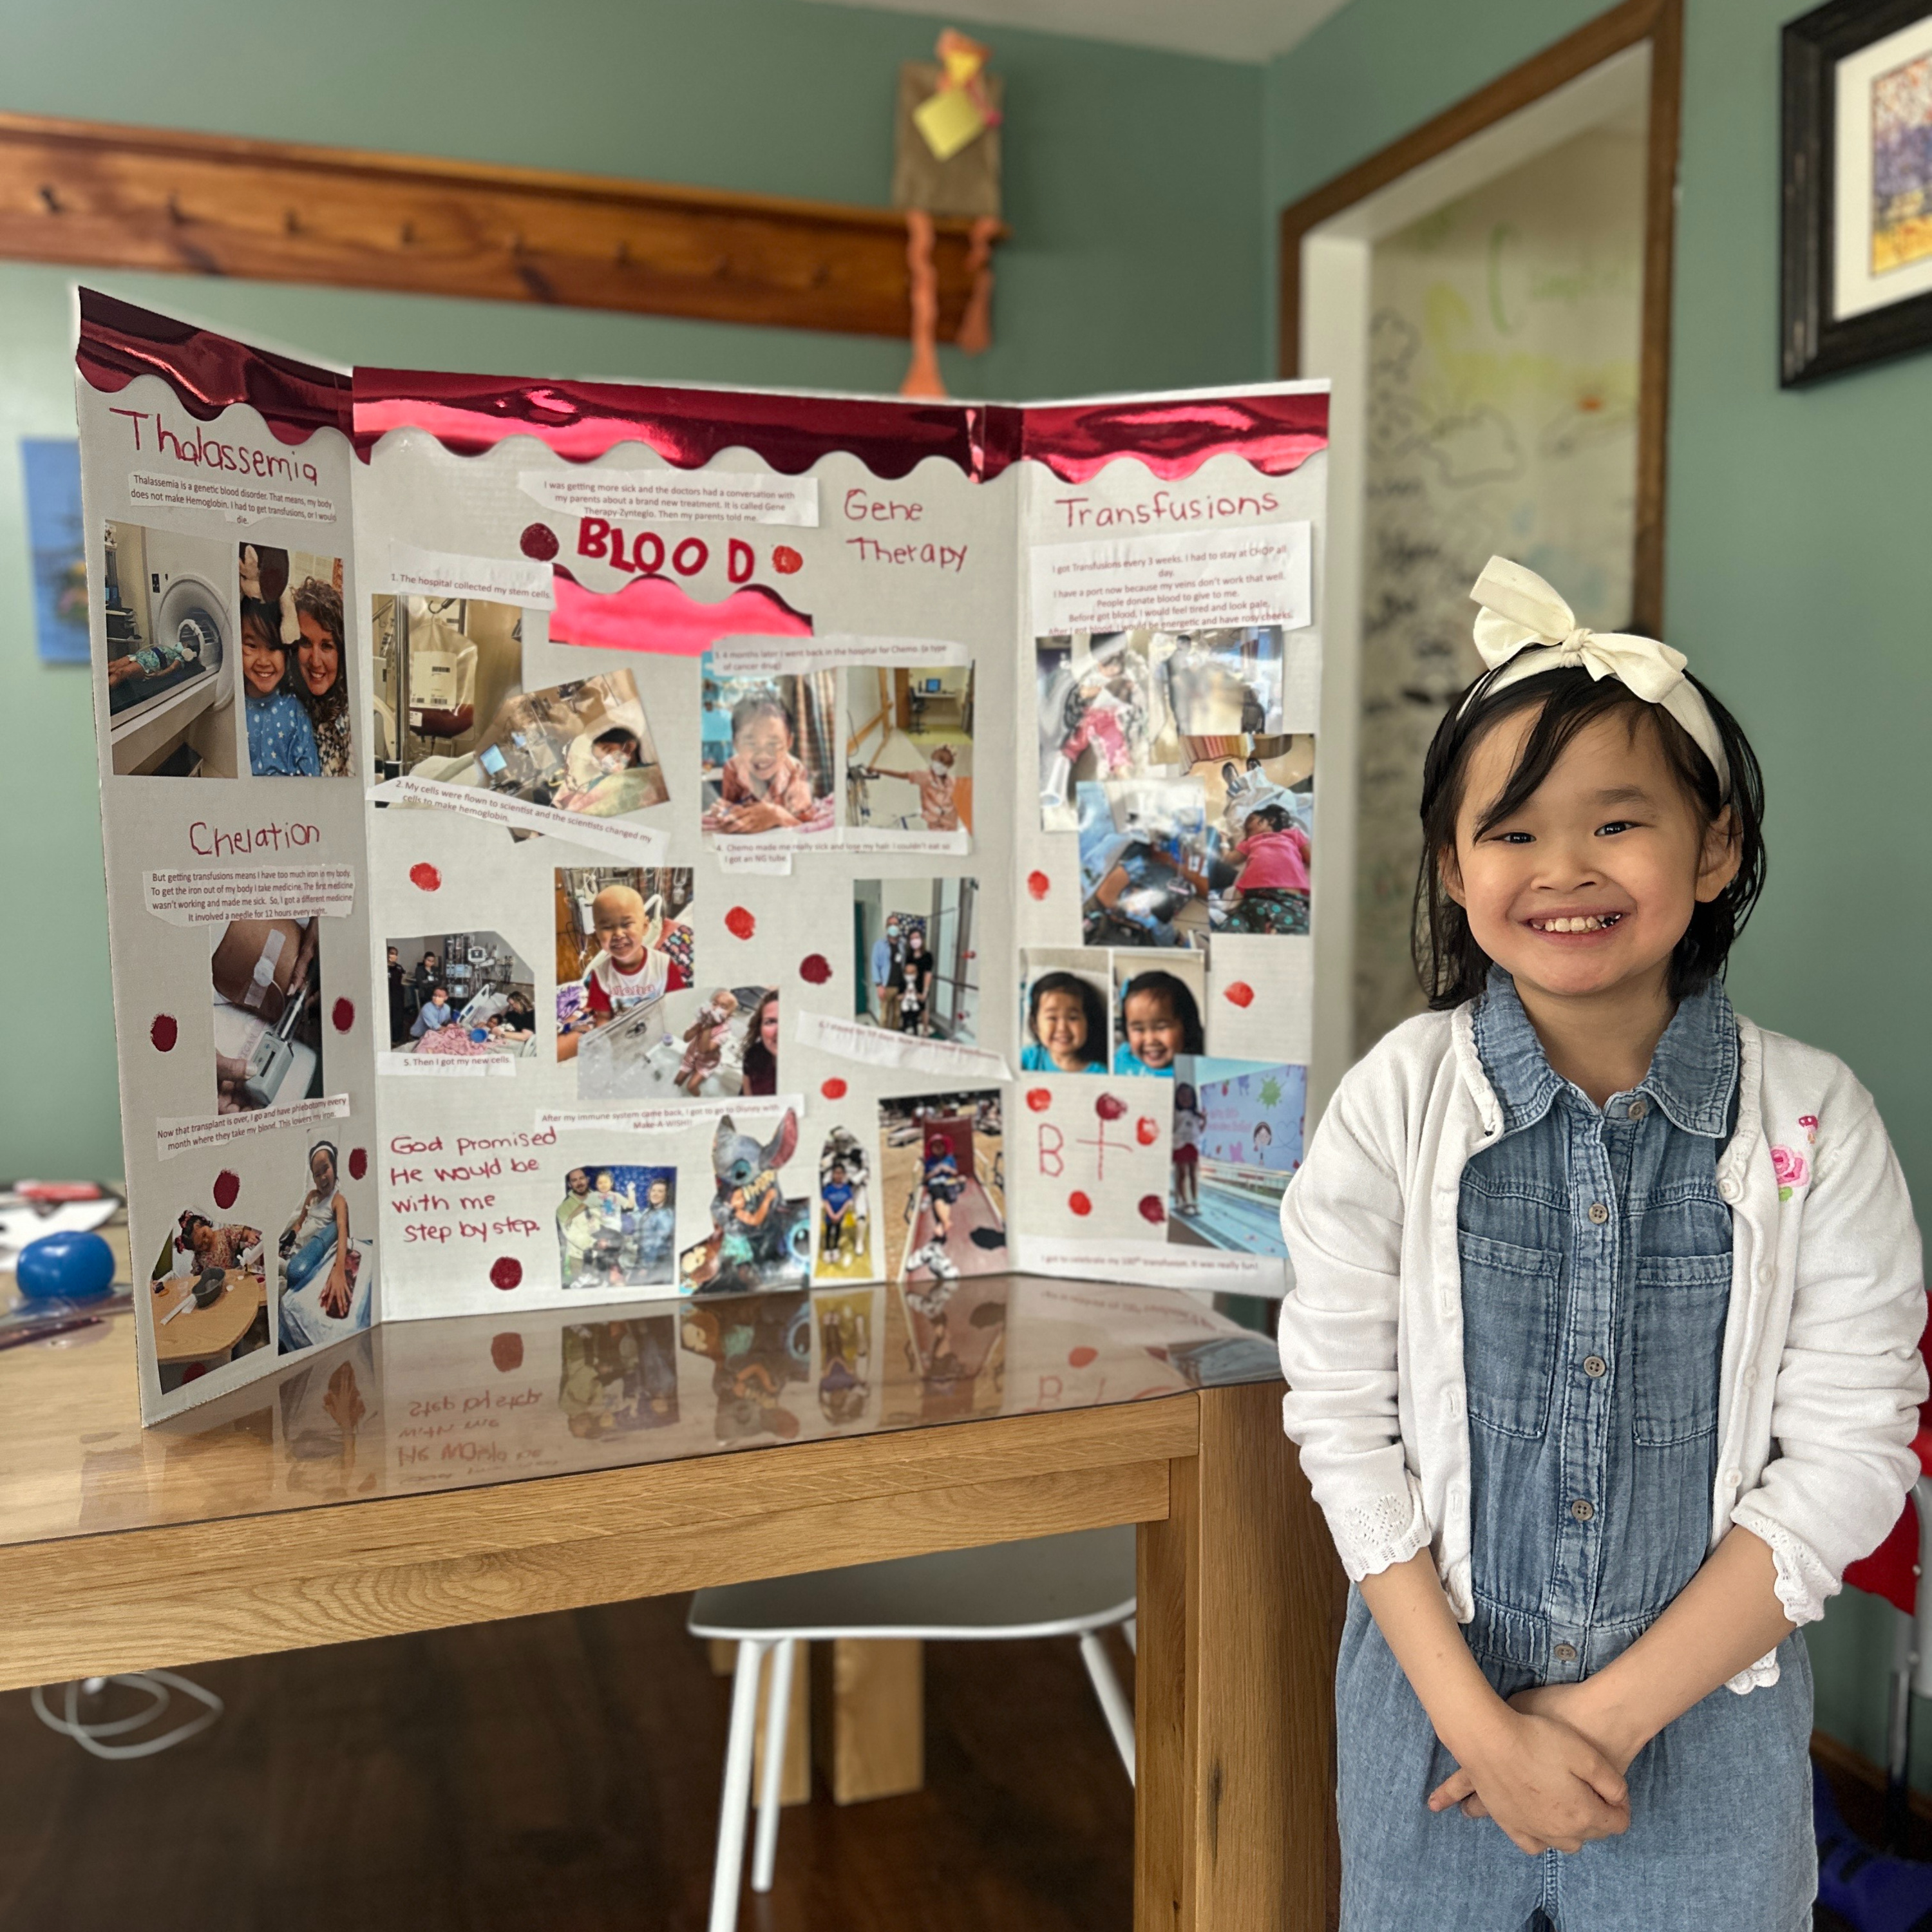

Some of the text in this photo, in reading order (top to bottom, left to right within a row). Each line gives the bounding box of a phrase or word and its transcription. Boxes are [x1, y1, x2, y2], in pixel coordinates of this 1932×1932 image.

[109, 408, 317, 486] Thalassemia
[131, 488, 149, 499] does
[150, 493, 164, 501] not
[165, 493, 184, 503] make
[234, 501, 247, 511] had
[248, 504, 256, 512] to
[257, 506, 267, 515] get
[133, 474, 179, 489] Thalassemia
[180, 480, 187, 489] is
[194, 484, 219, 494] genetic
[220, 485, 239, 496] blood
[269, 492, 283, 502] That
[307, 499, 316, 508] my
[317, 498, 332, 511] body
[555, 495, 567, 504] my
[602, 496, 627, 504] about
[636, 497, 659, 506] brand
[740, 502, 763, 511] called
[764, 503, 786, 511] Gene
[567, 482, 596, 493] getting
[621, 484, 636, 493] sick
[671, 486, 701, 495] doctors
[703, 488, 717, 497] had
[659, 510, 678, 518] Then
[680, 513, 693, 521] my
[844, 489, 923, 520] Gene
[1055, 491, 1280, 527] Transfusions
[236, 515, 249, 524] die.
[578, 516, 755, 583] BLOOD
[846, 537, 967, 572] Therapy
[1057, 565, 1070, 574] got
[1072, 561, 1122, 572] Transfusions
[1123, 560, 1146, 568] every
[1191, 553, 1206, 562] had
[1220, 552, 1237, 560] stay
[1276, 545, 1287, 554] all
[400, 574, 416, 583] The
[419, 576, 451, 587] hospital
[454, 581, 492, 592] collected
[494, 587, 507, 596] my
[509, 588, 529, 596] stem
[1158, 569, 1175, 578] day.
[1097, 598, 1124, 609] People
[1126, 597, 1155, 605] donate
[1157, 594, 1180, 603] blood
[1193, 592, 1211, 602] give
[402, 795, 422, 804] cells
[434, 801, 457, 810] make
[405, 782, 419, 792] My
[421, 786, 439, 795] cells
[441, 791, 462, 800] were
[464, 793, 488, 805] flown
[500, 802, 534, 815] scientist
[535, 810, 551, 819] and
[552, 813, 566, 822] the
[567, 817, 604, 831] scientists
[605, 825, 639, 838] changed
[639, 834, 652, 844] my
[190, 822, 319, 857] Chelation
[152, 873, 166, 882] But
[167, 872, 191, 884] getting
[193, 871, 234, 881] transfusions
[261, 871, 276, 879] have
[413, 1057, 434, 1066] Then
[441, 1058, 455, 1067] got
[157, 1130, 174, 1139] Now
[175, 1126, 190, 1136] that
[191, 1120, 225, 1133] transplant
[227, 1118, 232, 1126] is
[254, 1114, 263, 1123] go
[263, 1110, 276, 1119] and
[276, 1108, 290, 1117] have
[292, 1101, 327, 1116] phlebotomy
[327, 1098, 346, 1107] every
[391, 1126, 556, 1155] God promised
[390, 1158, 539, 1186] He would be
[392, 1194, 495, 1213] with me
[459, 1221, 487, 1242] by
[493, 1217, 540, 1237] step.
